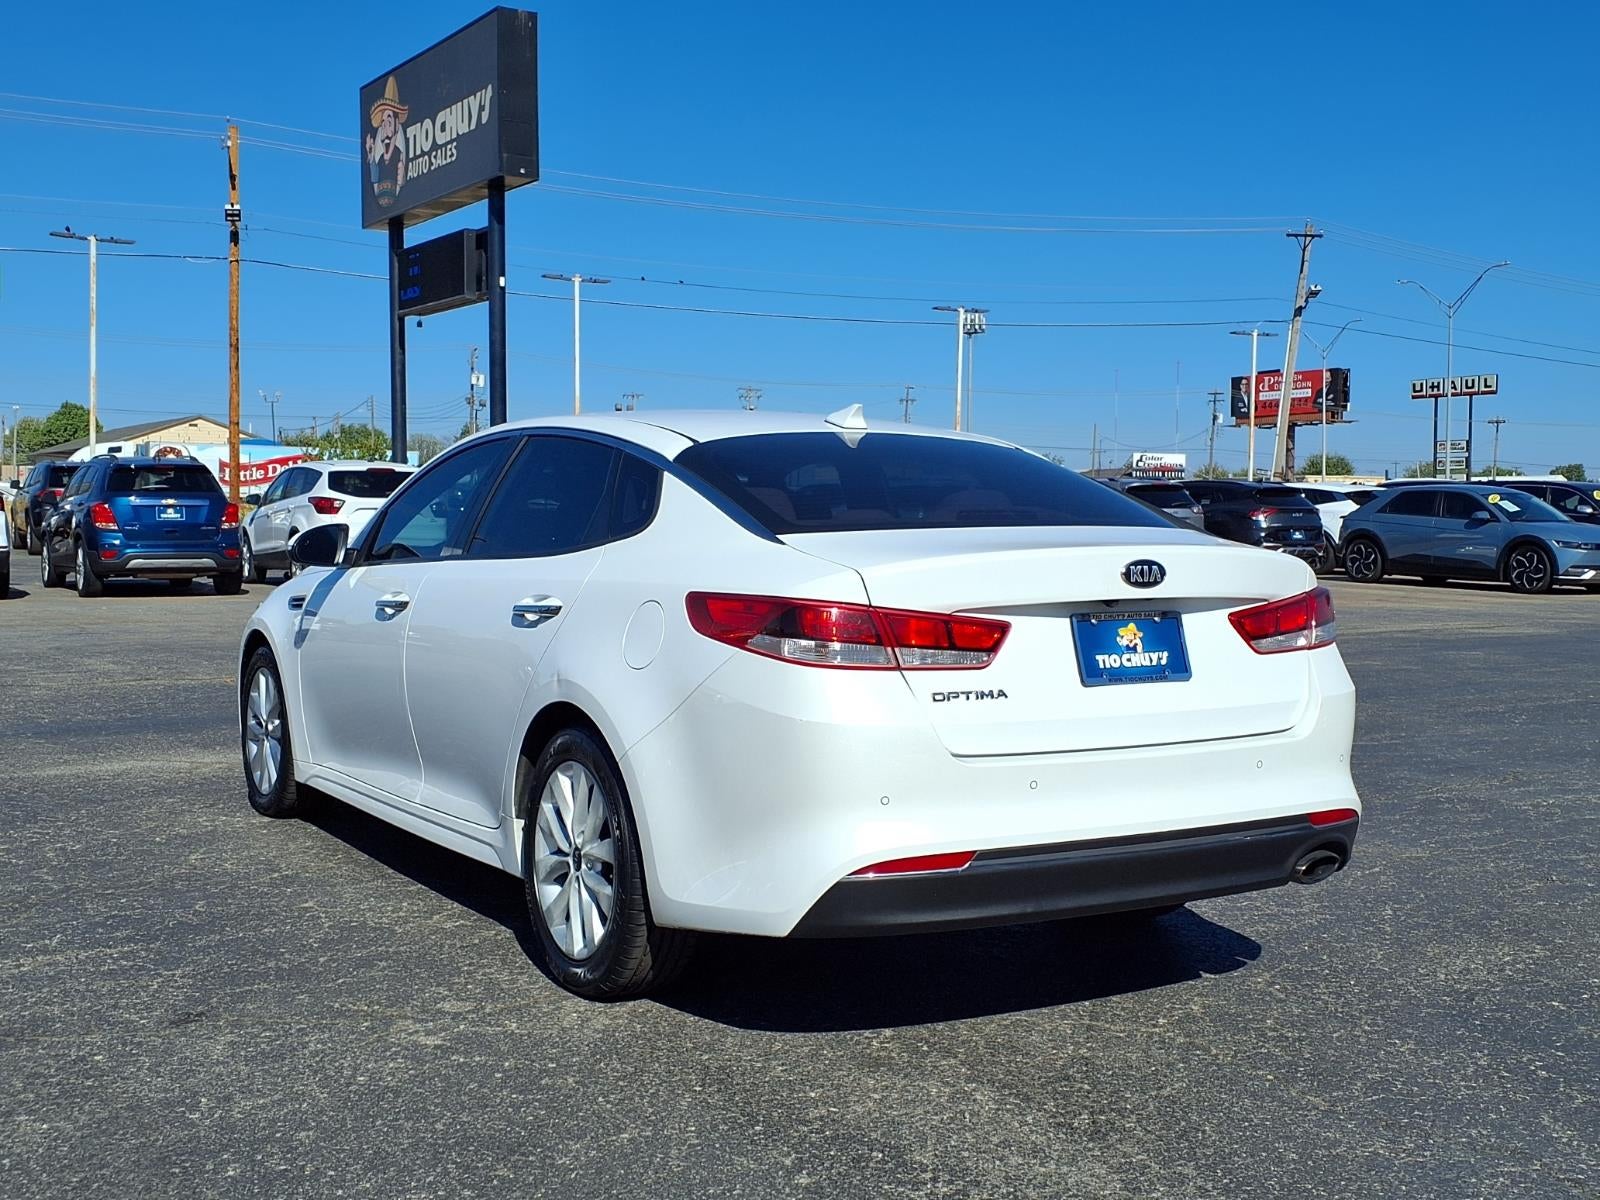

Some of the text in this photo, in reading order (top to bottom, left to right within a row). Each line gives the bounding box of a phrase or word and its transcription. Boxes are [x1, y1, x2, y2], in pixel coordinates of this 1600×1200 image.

[406, 83, 493, 159] TIO CHUY'S
[407, 142, 457, 181] AUTO SALES
[1140, 454, 1164, 462] Color
[223, 467, 265, 481] Lttle
[1129, 565, 1161, 582] KIA
[1095, 651, 1168, 669] TIO CHUY'S
[932, 689, 1008, 702] OPTIMA
